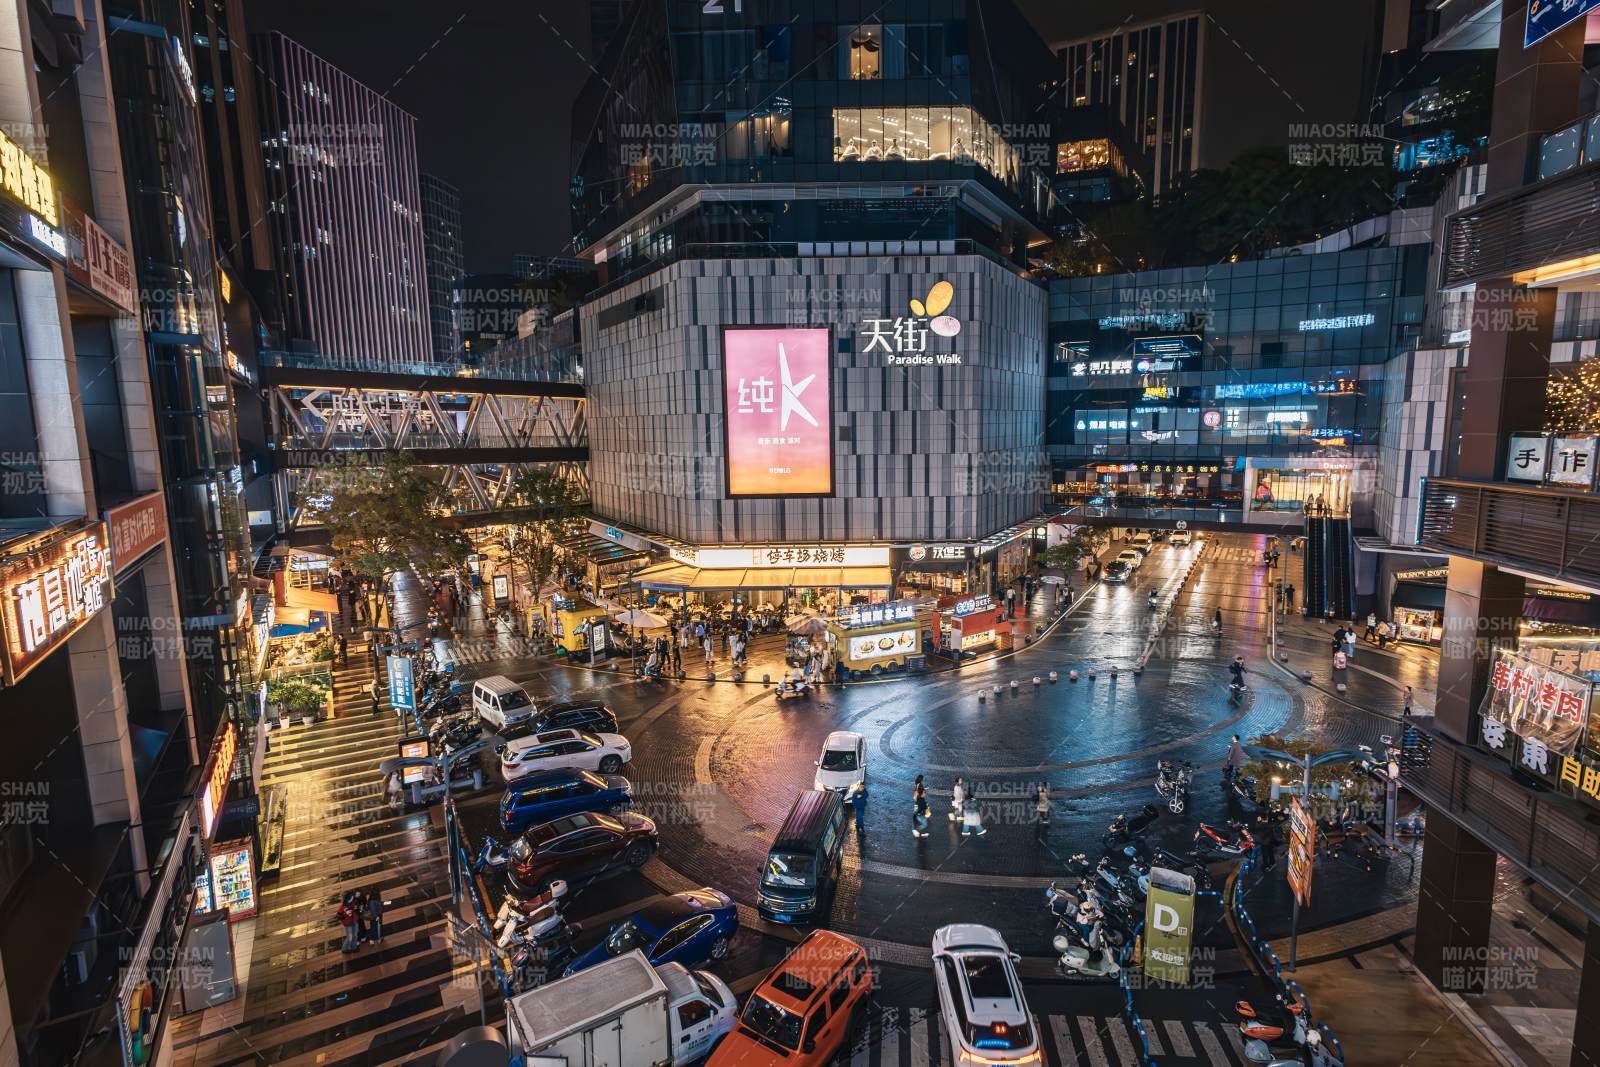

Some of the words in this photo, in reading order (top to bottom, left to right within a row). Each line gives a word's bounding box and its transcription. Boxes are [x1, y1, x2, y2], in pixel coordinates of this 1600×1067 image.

[861, 316, 929, 353] 天街
[888, 354, 934, 365] Paradise
[936, 354, 962, 365] Walk
[1513, 448, 1588, 474] 手作
[766, 547, 847, 565] 停车场烧烤
[932, 546, 966, 559] 汉堡王
[1153, 902, 1180, 932] D
